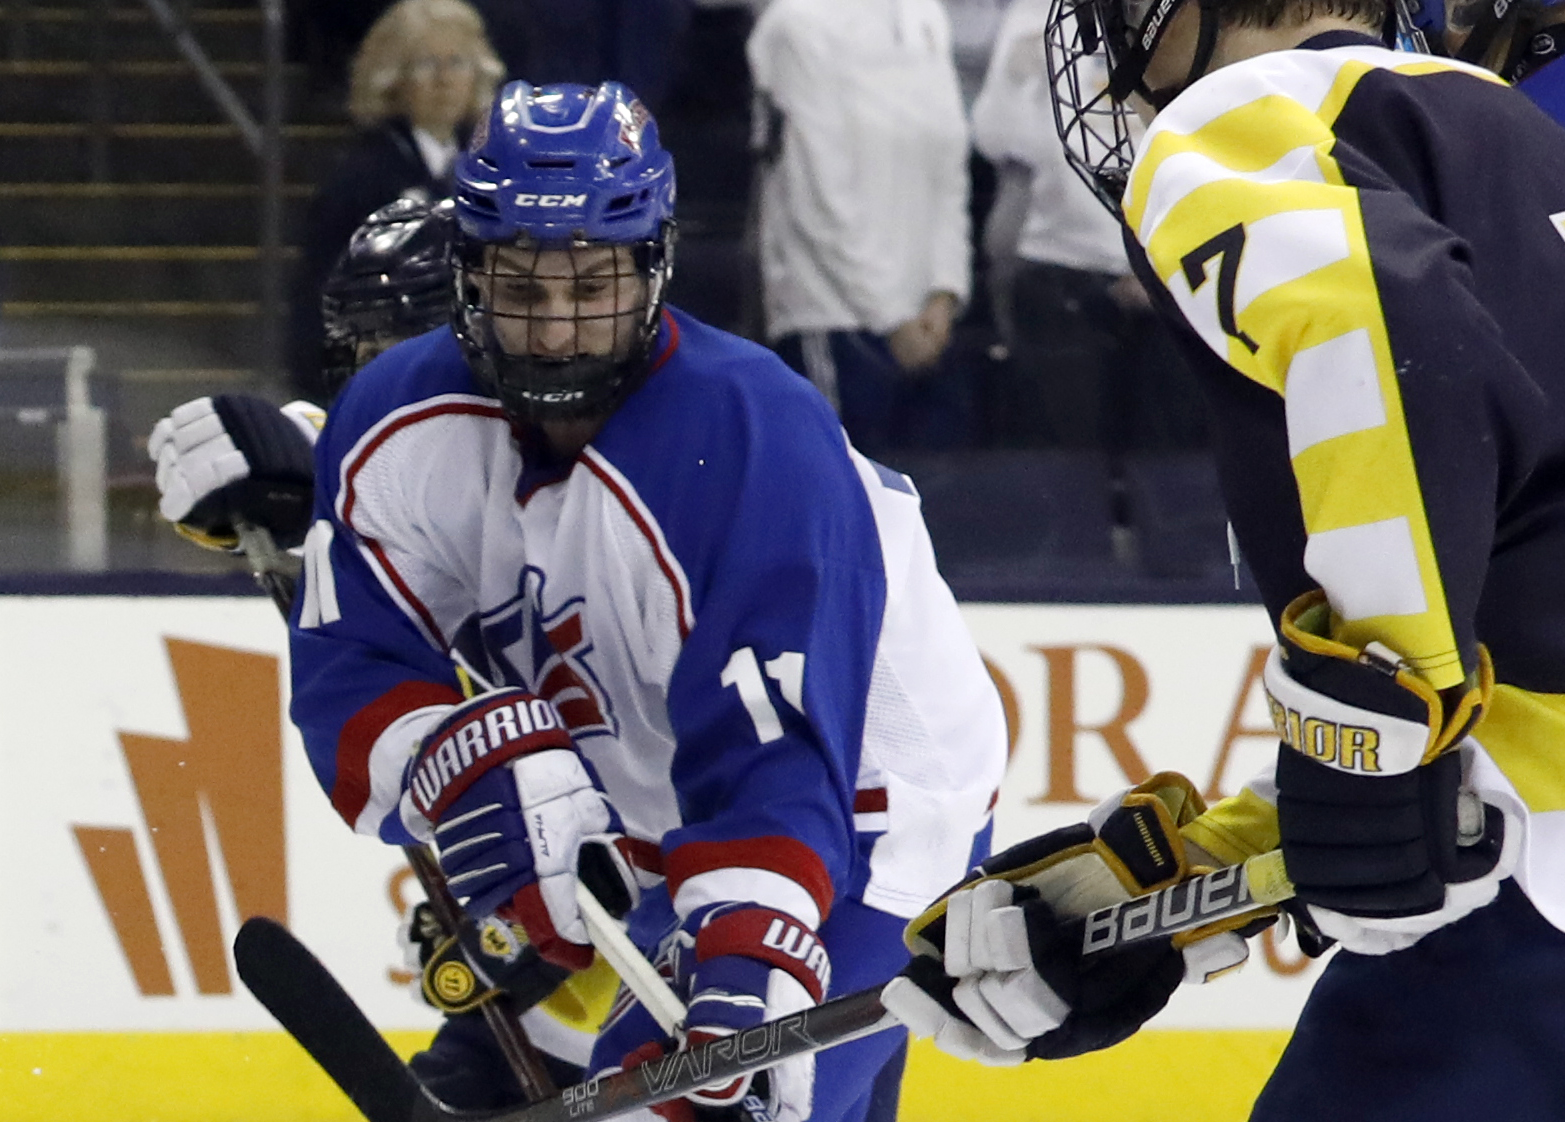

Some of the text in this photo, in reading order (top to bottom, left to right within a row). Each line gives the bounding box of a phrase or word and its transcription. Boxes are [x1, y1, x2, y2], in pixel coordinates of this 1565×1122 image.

[1142, 0, 1175, 51] BAUE
[514, 193, 588, 208] CCM
[1180, 222, 1261, 356] 7
[641, 1011, 824, 1096] VAPOR
[563, 1079, 599, 1107] 900
